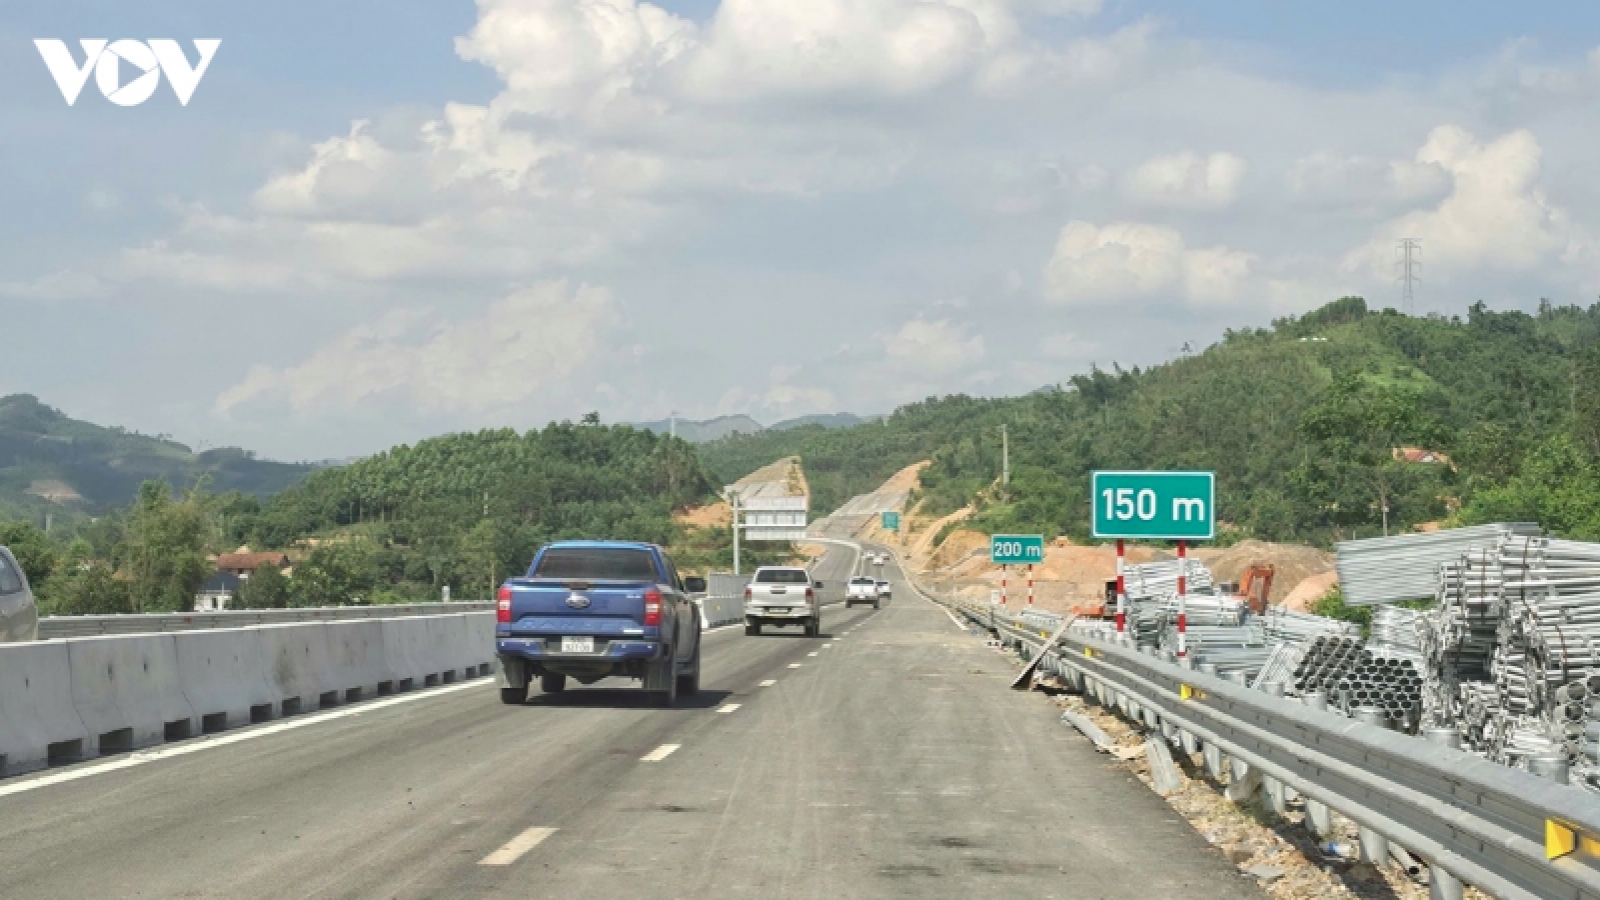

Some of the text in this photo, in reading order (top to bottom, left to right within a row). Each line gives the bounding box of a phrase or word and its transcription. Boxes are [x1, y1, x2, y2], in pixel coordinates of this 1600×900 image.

[1102, 487, 1205, 521] 150 m
[994, 541, 1041, 557] 200 m
